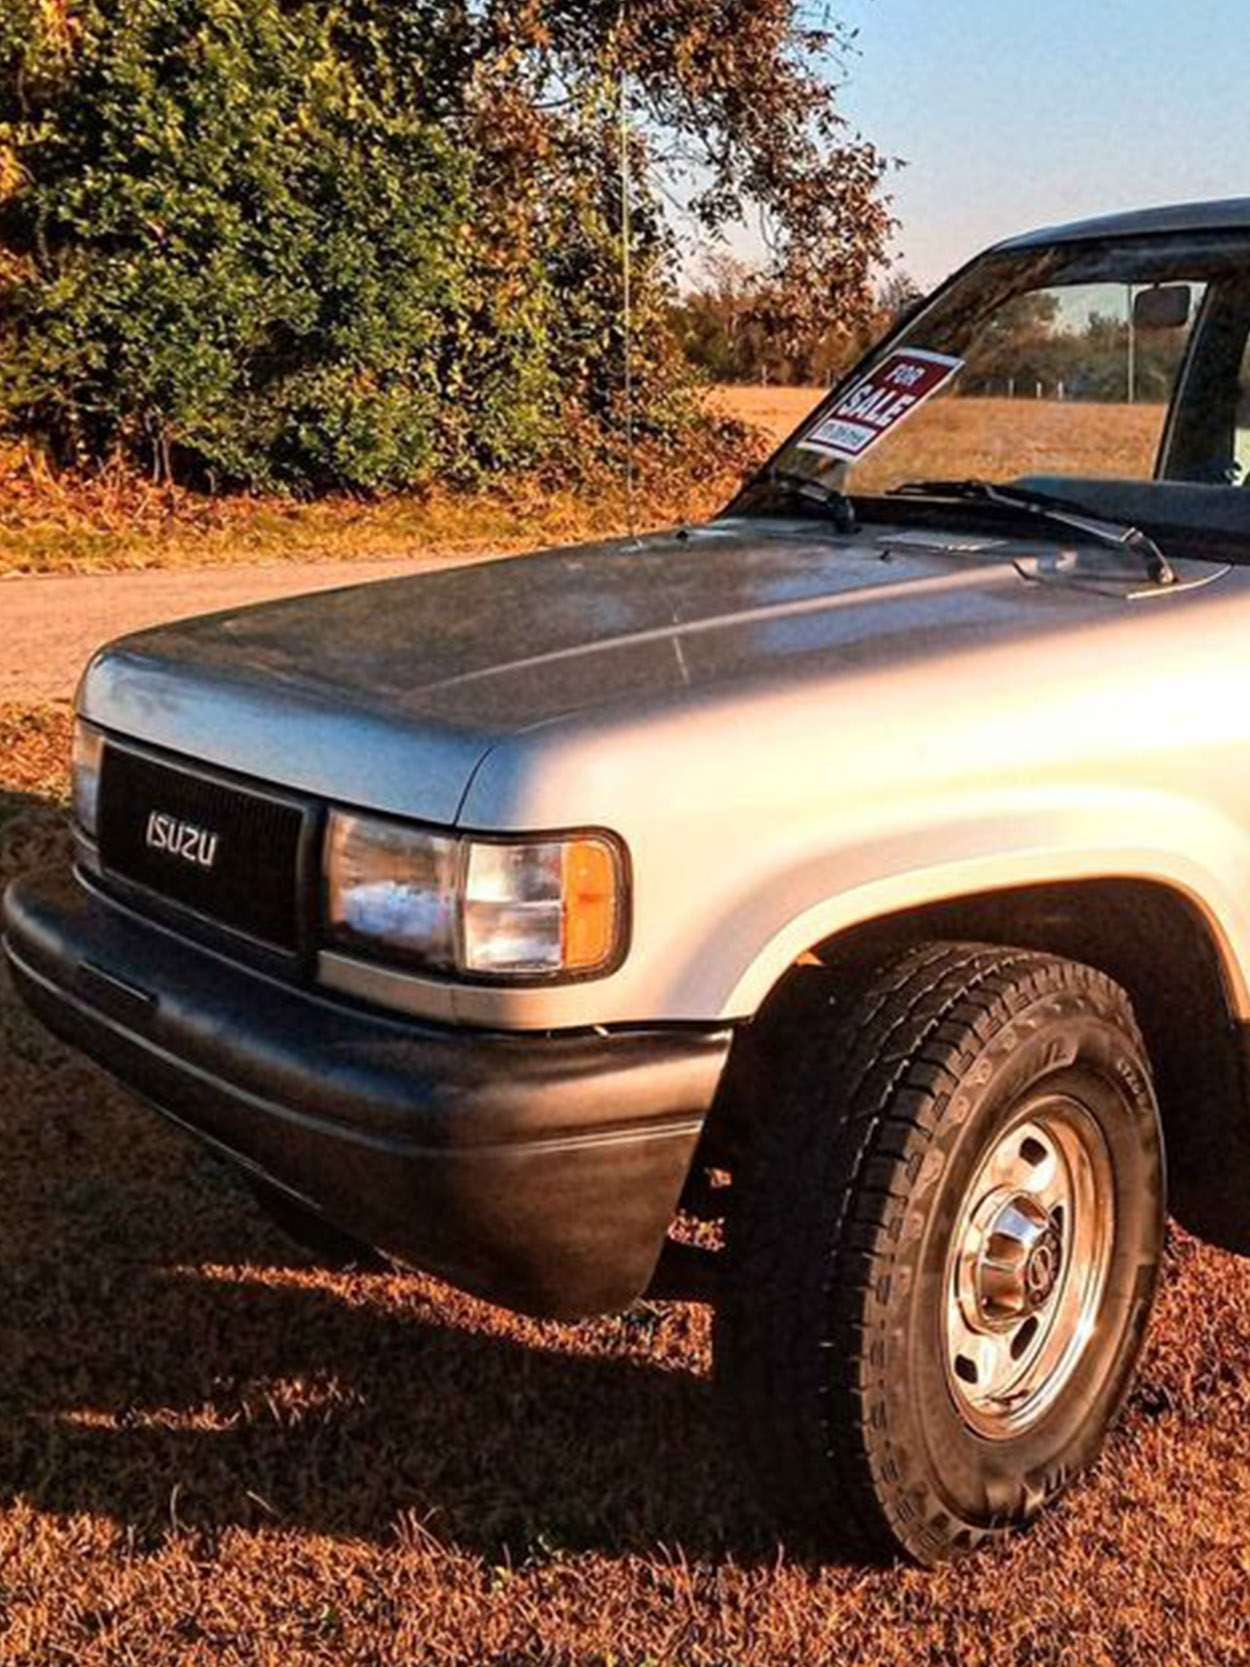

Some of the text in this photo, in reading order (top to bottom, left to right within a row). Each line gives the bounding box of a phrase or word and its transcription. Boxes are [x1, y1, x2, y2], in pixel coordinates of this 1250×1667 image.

[884, 363, 926, 387] FOR
[837, 383, 917, 427] SALE
[146, 810, 218, 867] ISUZU
